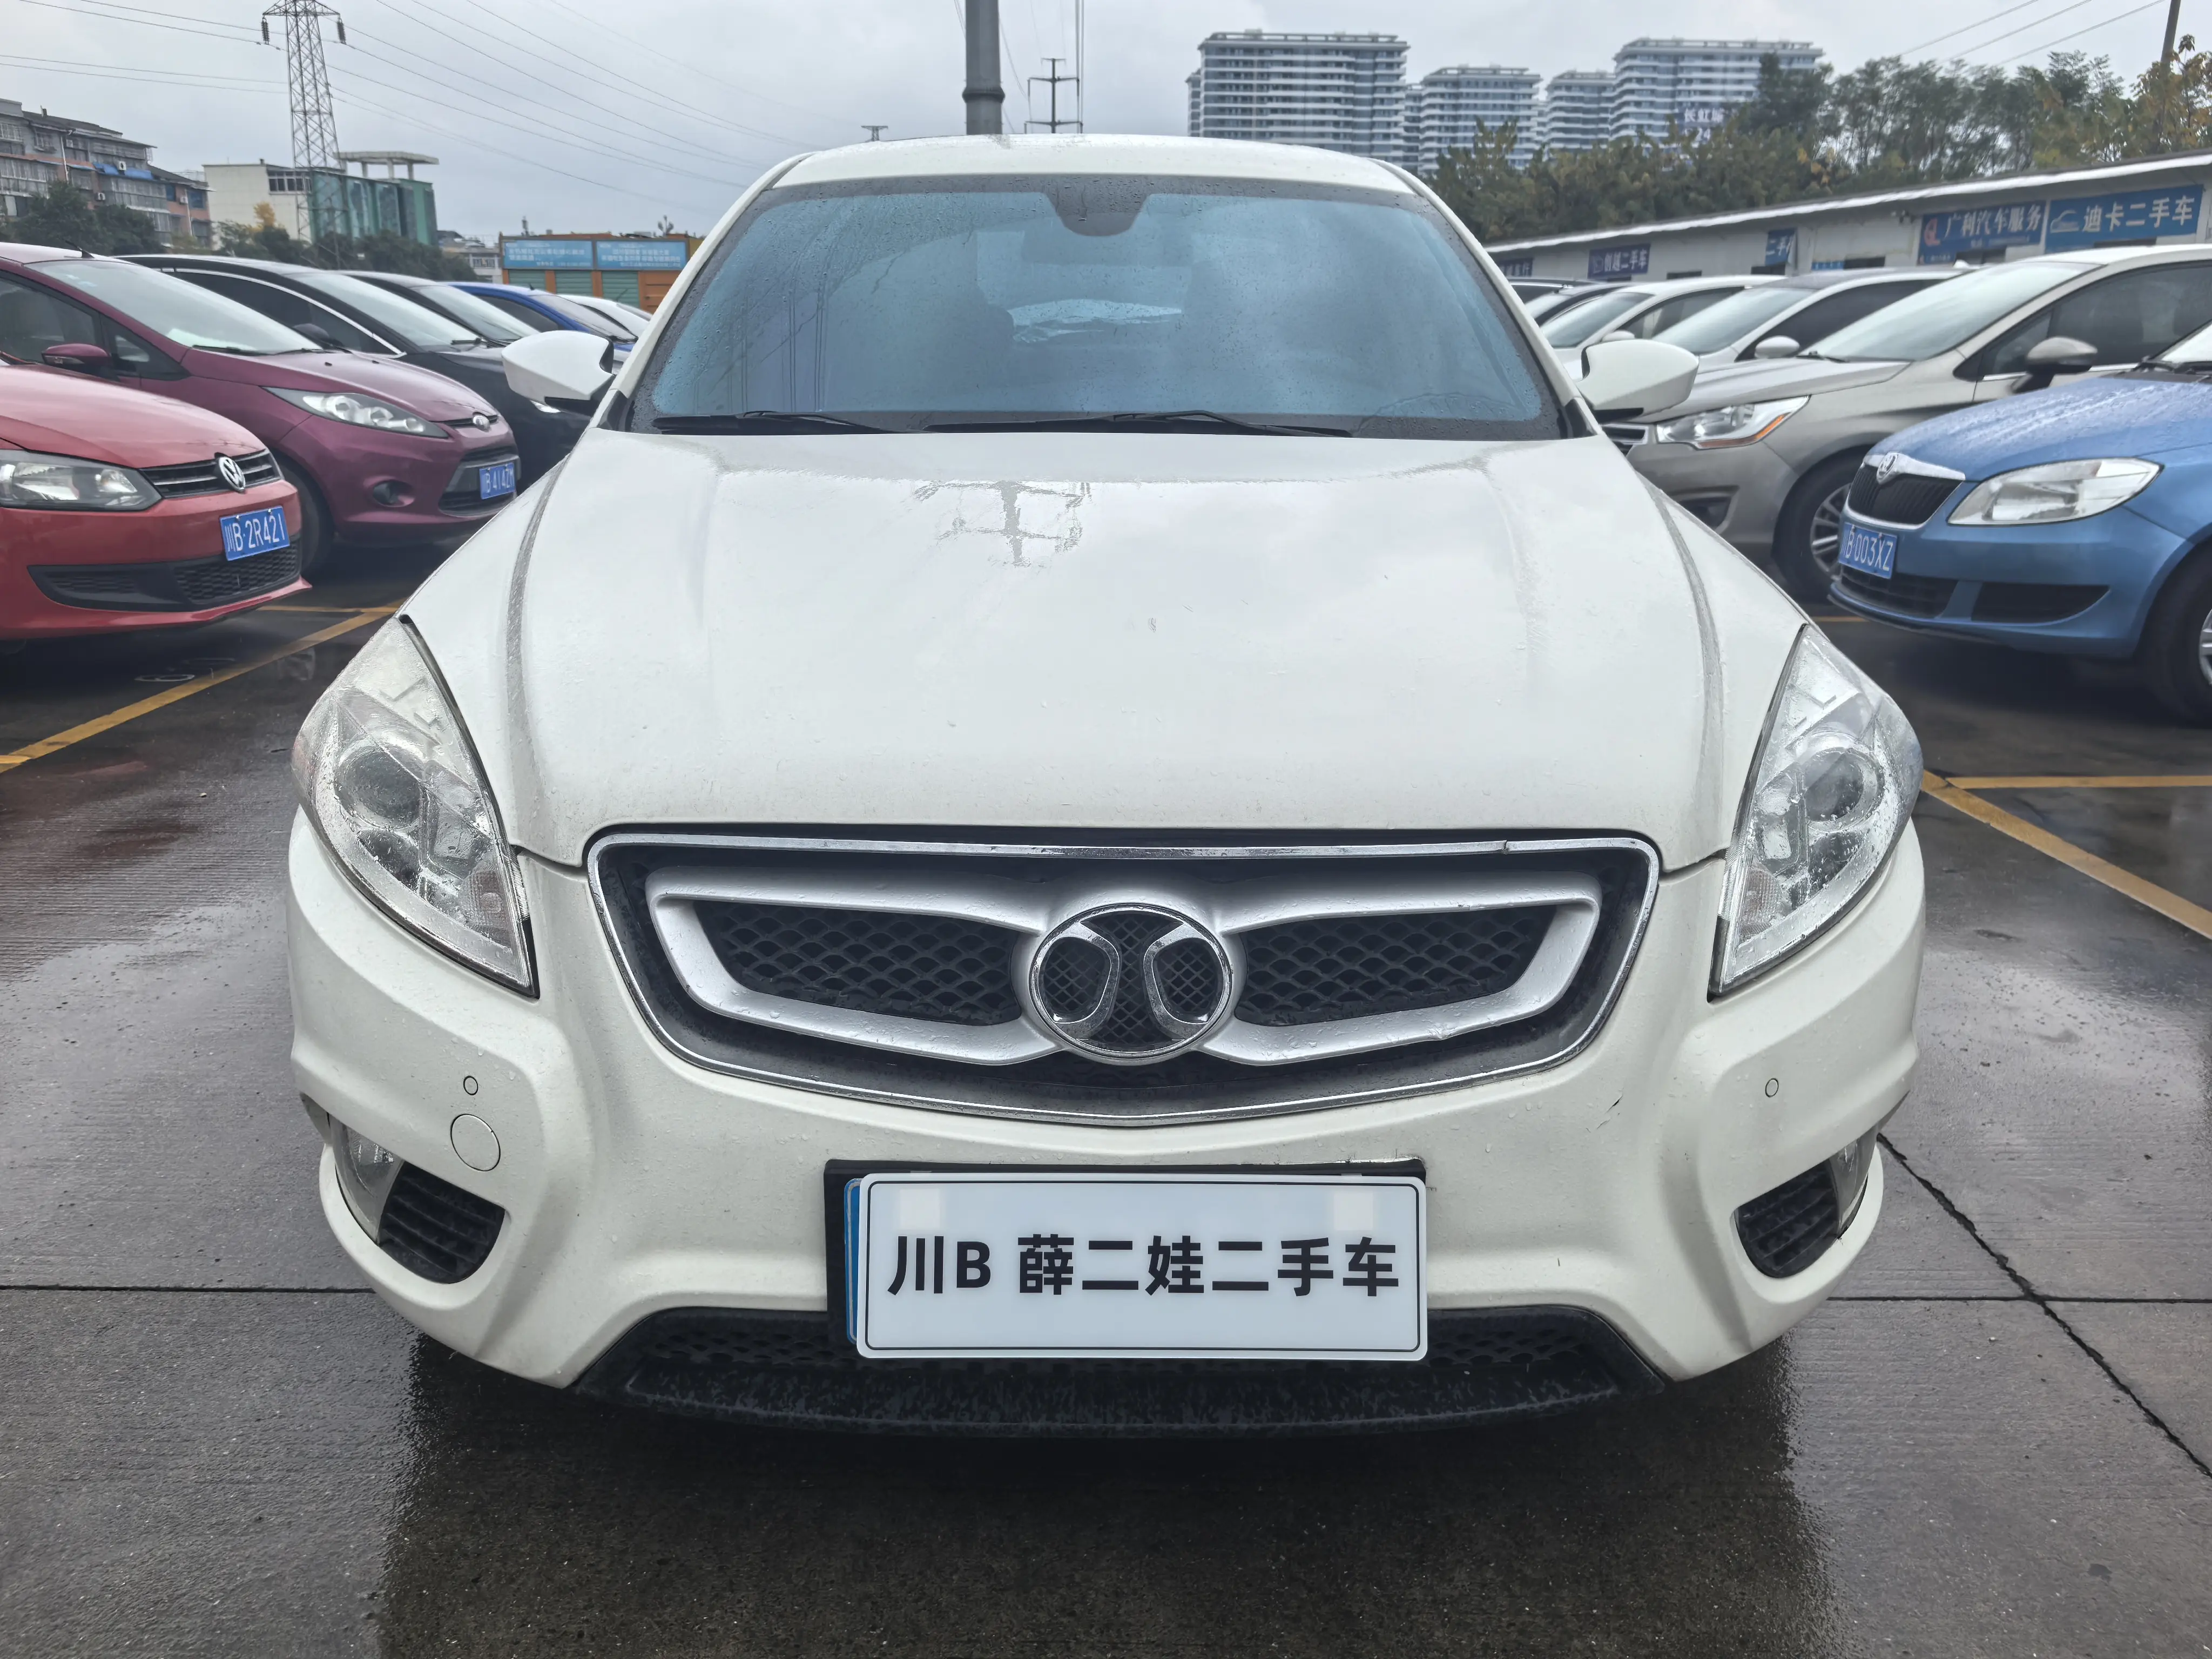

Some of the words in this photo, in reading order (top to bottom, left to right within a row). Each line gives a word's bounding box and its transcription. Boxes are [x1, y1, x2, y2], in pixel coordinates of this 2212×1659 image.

[1945, 204, 2041, 238] 广利汽车服务
[2082, 195, 2194, 232] 迪卡二手车
[888, 1236, 990, 1295] 川B
[1018, 1234, 1398, 1296] 薛二娃二手车
